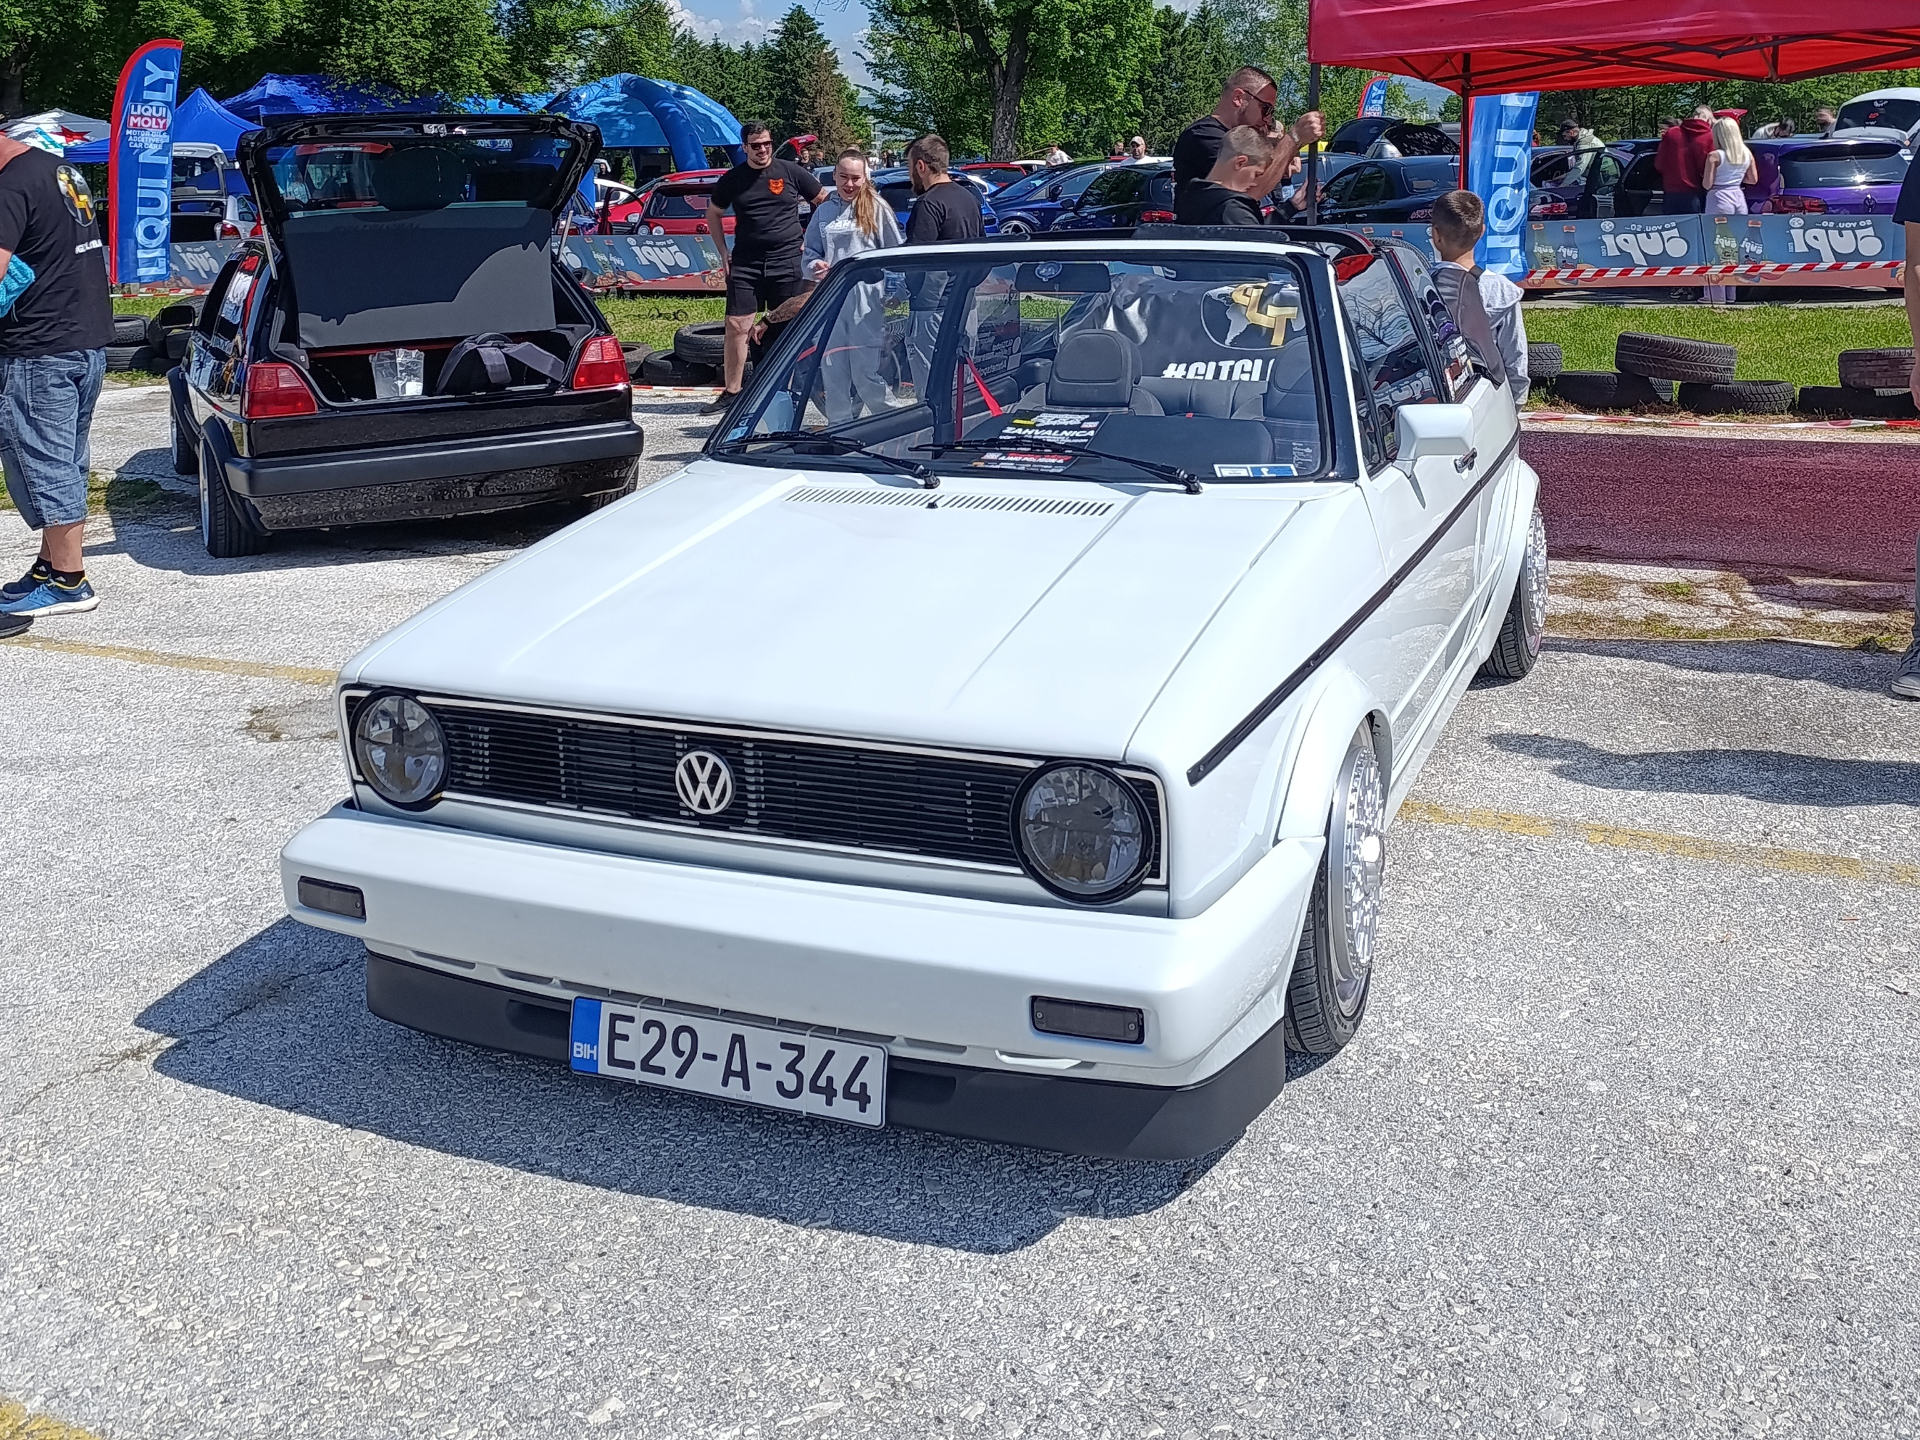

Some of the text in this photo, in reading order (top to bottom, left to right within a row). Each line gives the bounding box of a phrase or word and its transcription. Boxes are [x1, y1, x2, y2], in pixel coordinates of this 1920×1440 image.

[130, 104, 166, 117] LIQUI
[129, 116, 167, 130] MOLY
[1486, 129, 1528, 275] LIQUI
[135, 178, 169, 276] LIQUI
[1001, 426, 1095, 437] ZAHVALNICA
[572, 1041, 597, 1060] BIH
[606, 1012, 872, 1114] E29-A-344
